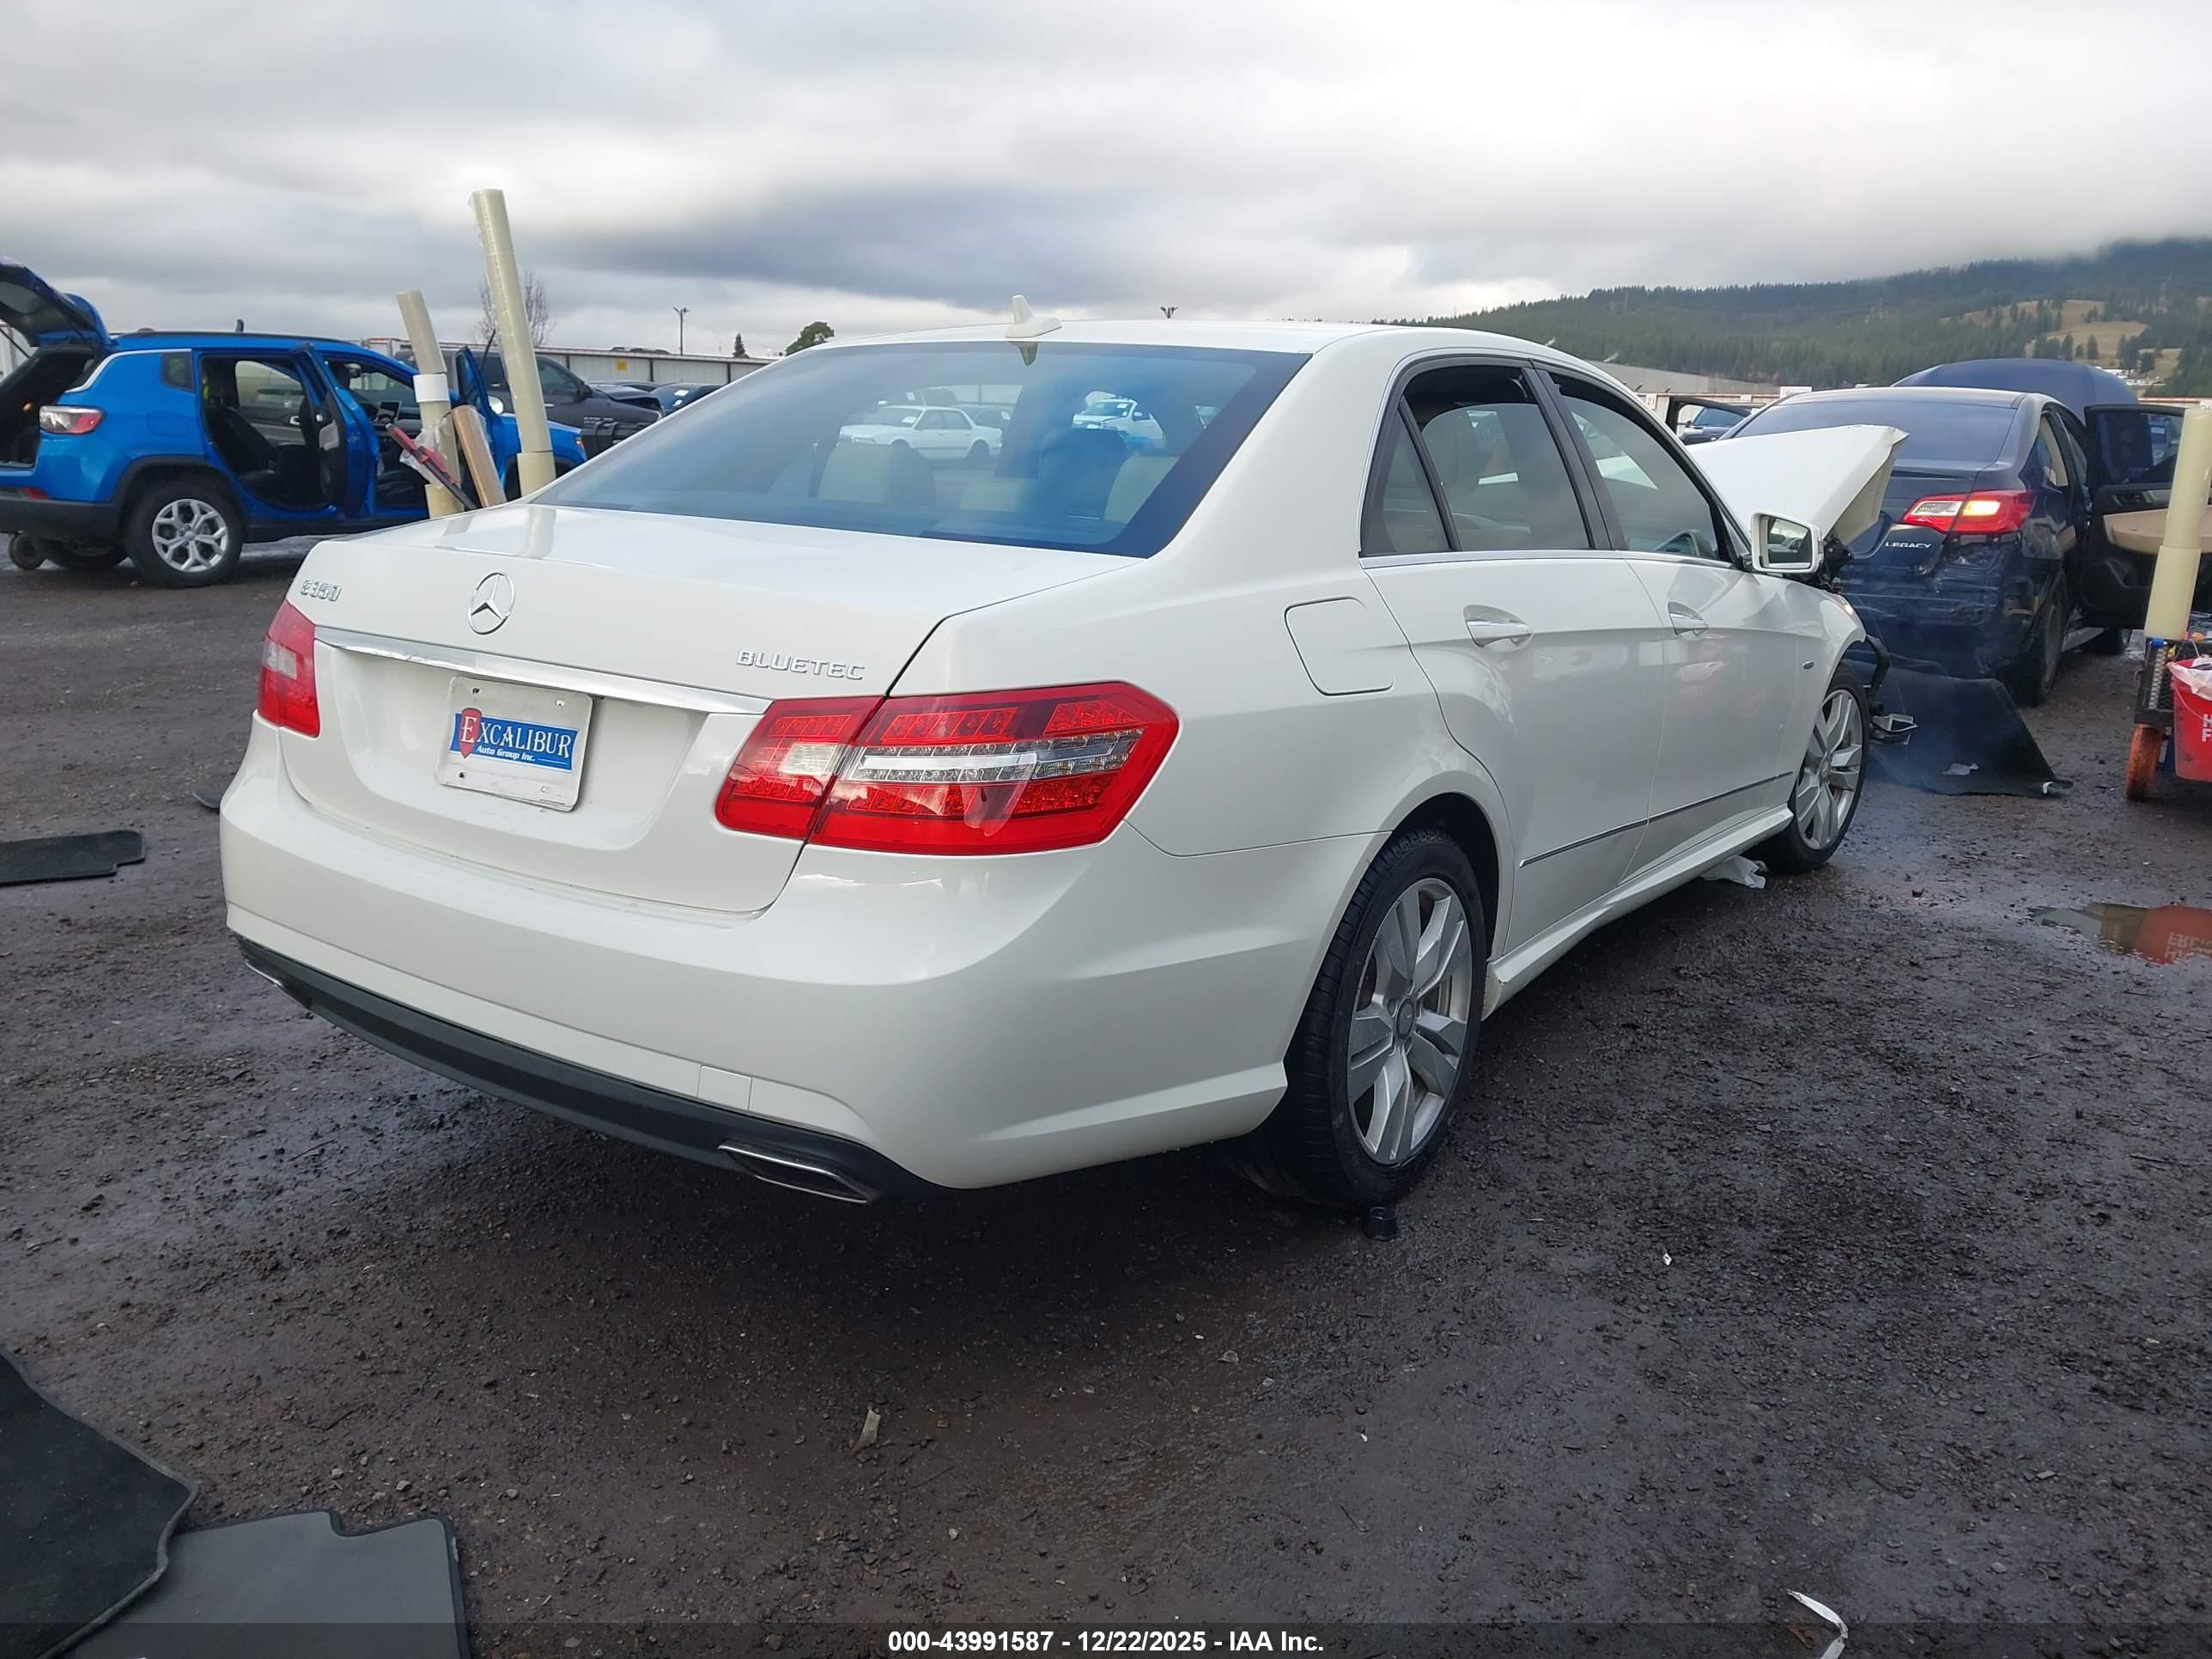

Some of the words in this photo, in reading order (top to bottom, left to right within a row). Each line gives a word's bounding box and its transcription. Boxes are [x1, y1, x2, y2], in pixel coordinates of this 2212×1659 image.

[301, 580, 343, 602] E350
[736, 649, 866, 681] BLUETEC
[461, 716, 571, 758] EXCALIBUR
[477, 744, 495, 755] Auto
[496, 748, 520, 760] Group
